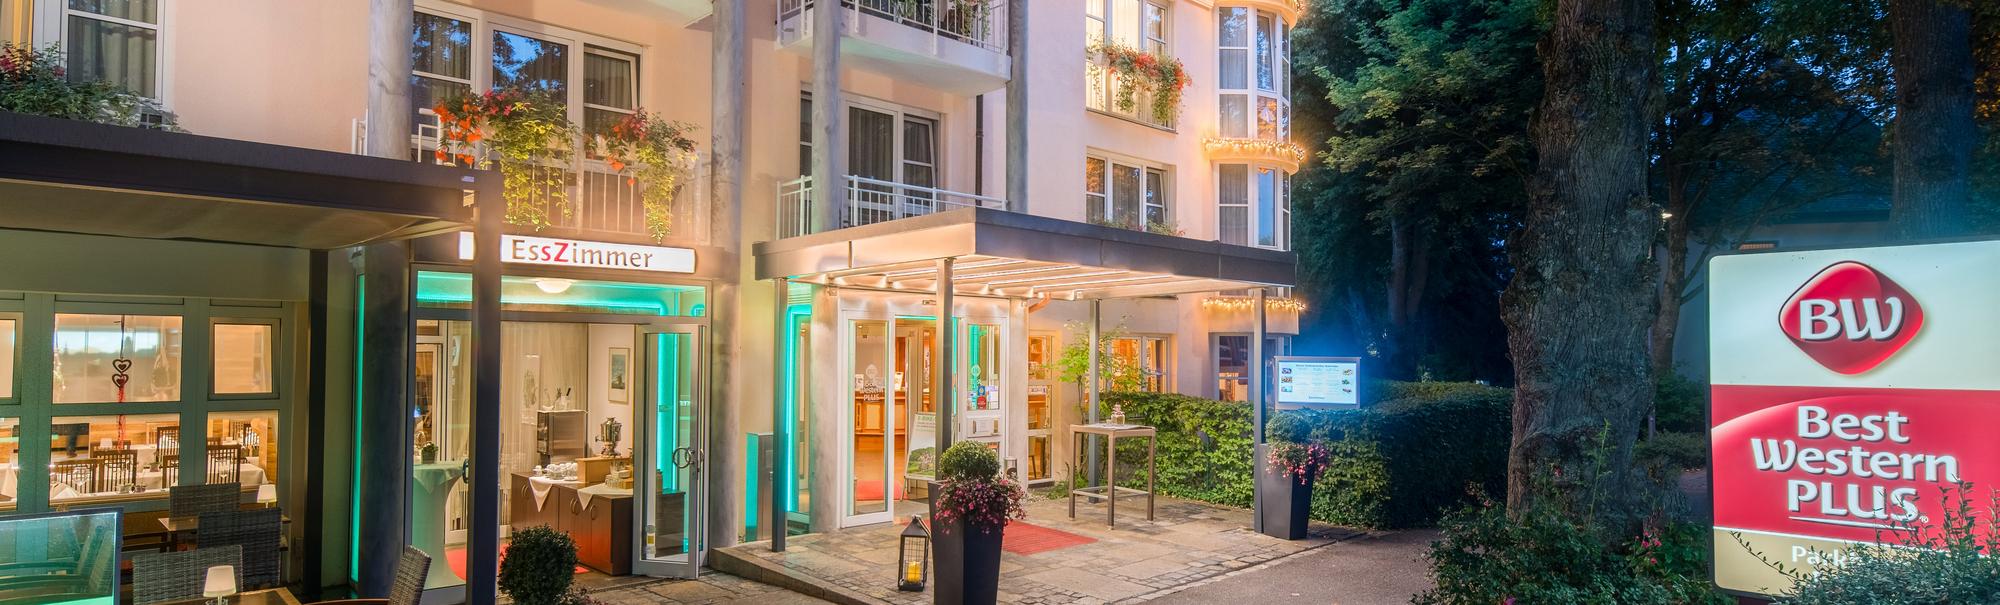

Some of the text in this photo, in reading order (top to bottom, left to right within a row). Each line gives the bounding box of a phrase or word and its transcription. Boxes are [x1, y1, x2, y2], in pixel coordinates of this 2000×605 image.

[511, 239, 653, 268] EssZimmer
[1799, 296, 1904, 341] BW
[1797, 405, 1911, 443] Best
[1750, 438, 1961, 484] Western
